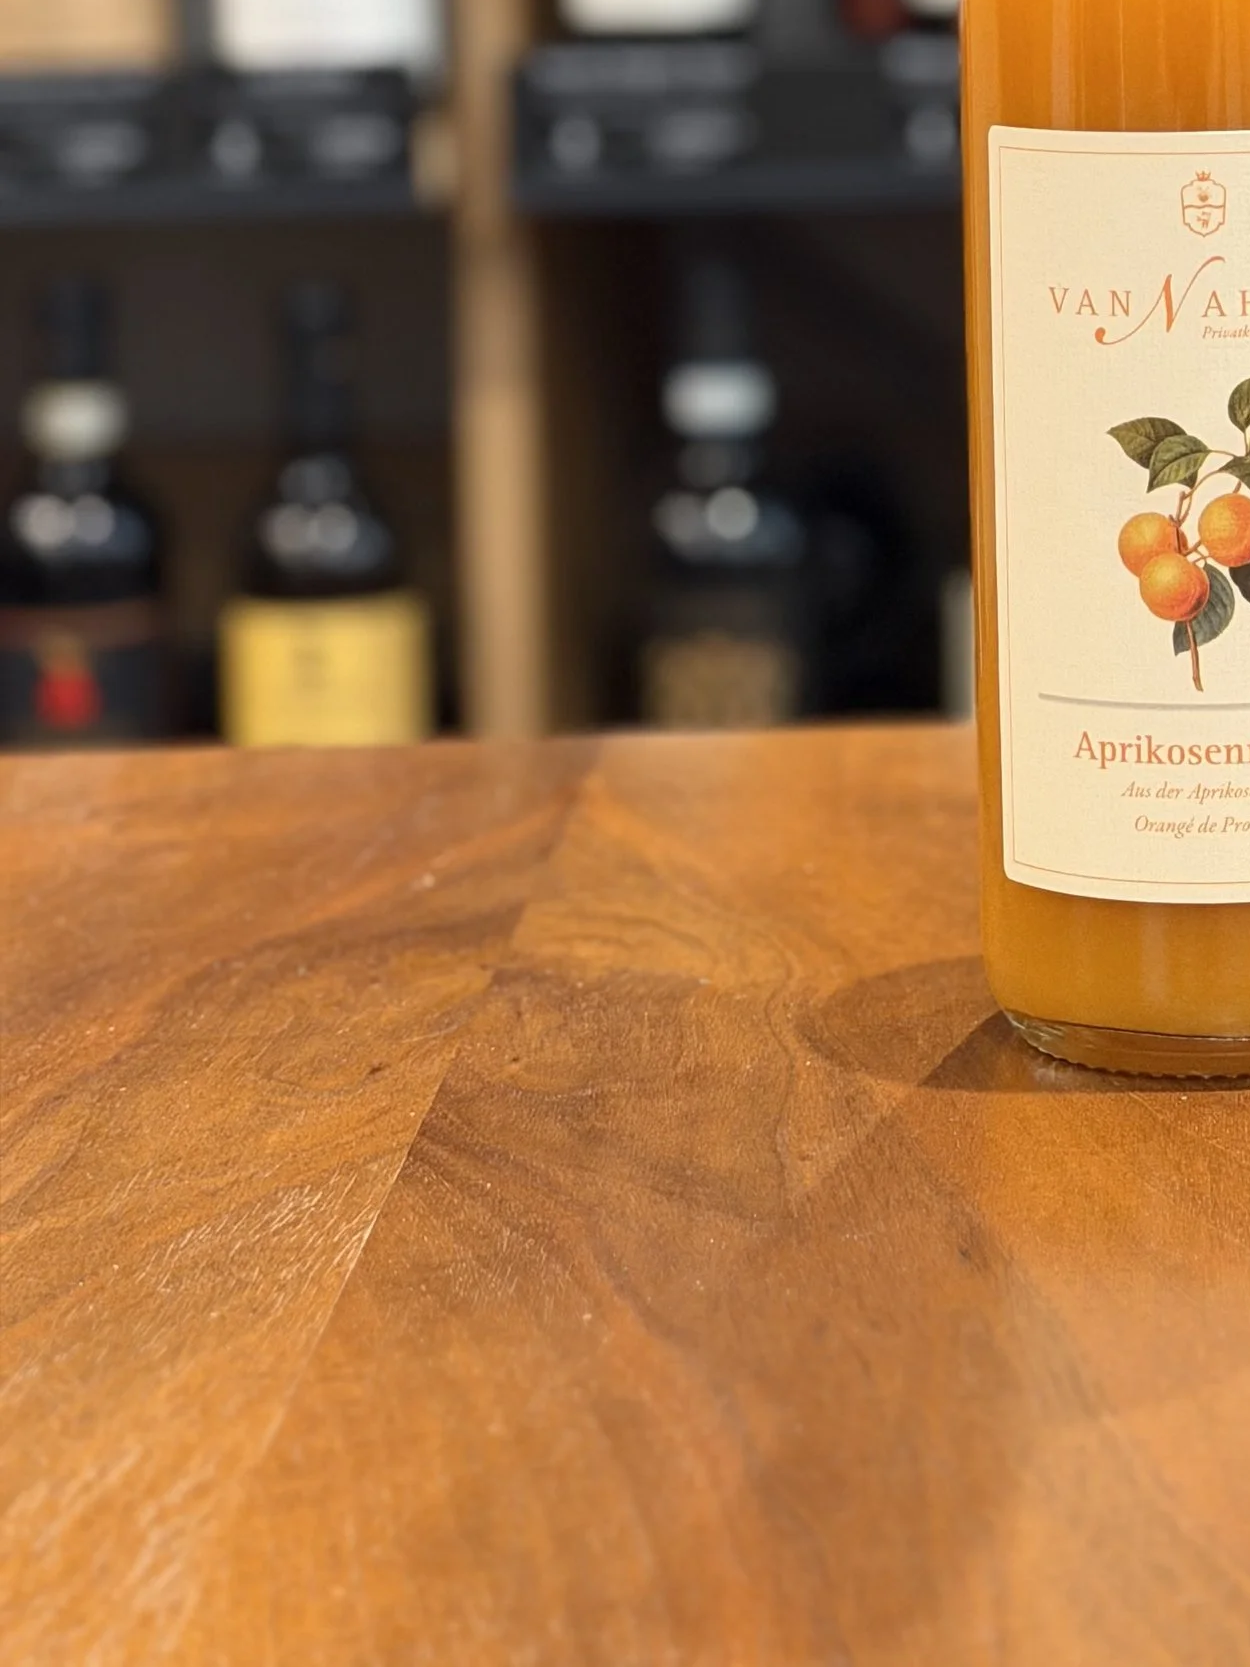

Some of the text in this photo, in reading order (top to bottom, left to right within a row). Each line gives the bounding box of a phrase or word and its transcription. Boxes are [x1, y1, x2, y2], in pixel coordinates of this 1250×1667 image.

[1048, 285, 1131, 318] VAN
[1120, 781, 1152, 799] Aus
[1155, 781, 1183, 799] der
[1134, 814, 1195, 839] Orangé
[1197, 816, 1217, 834] de
